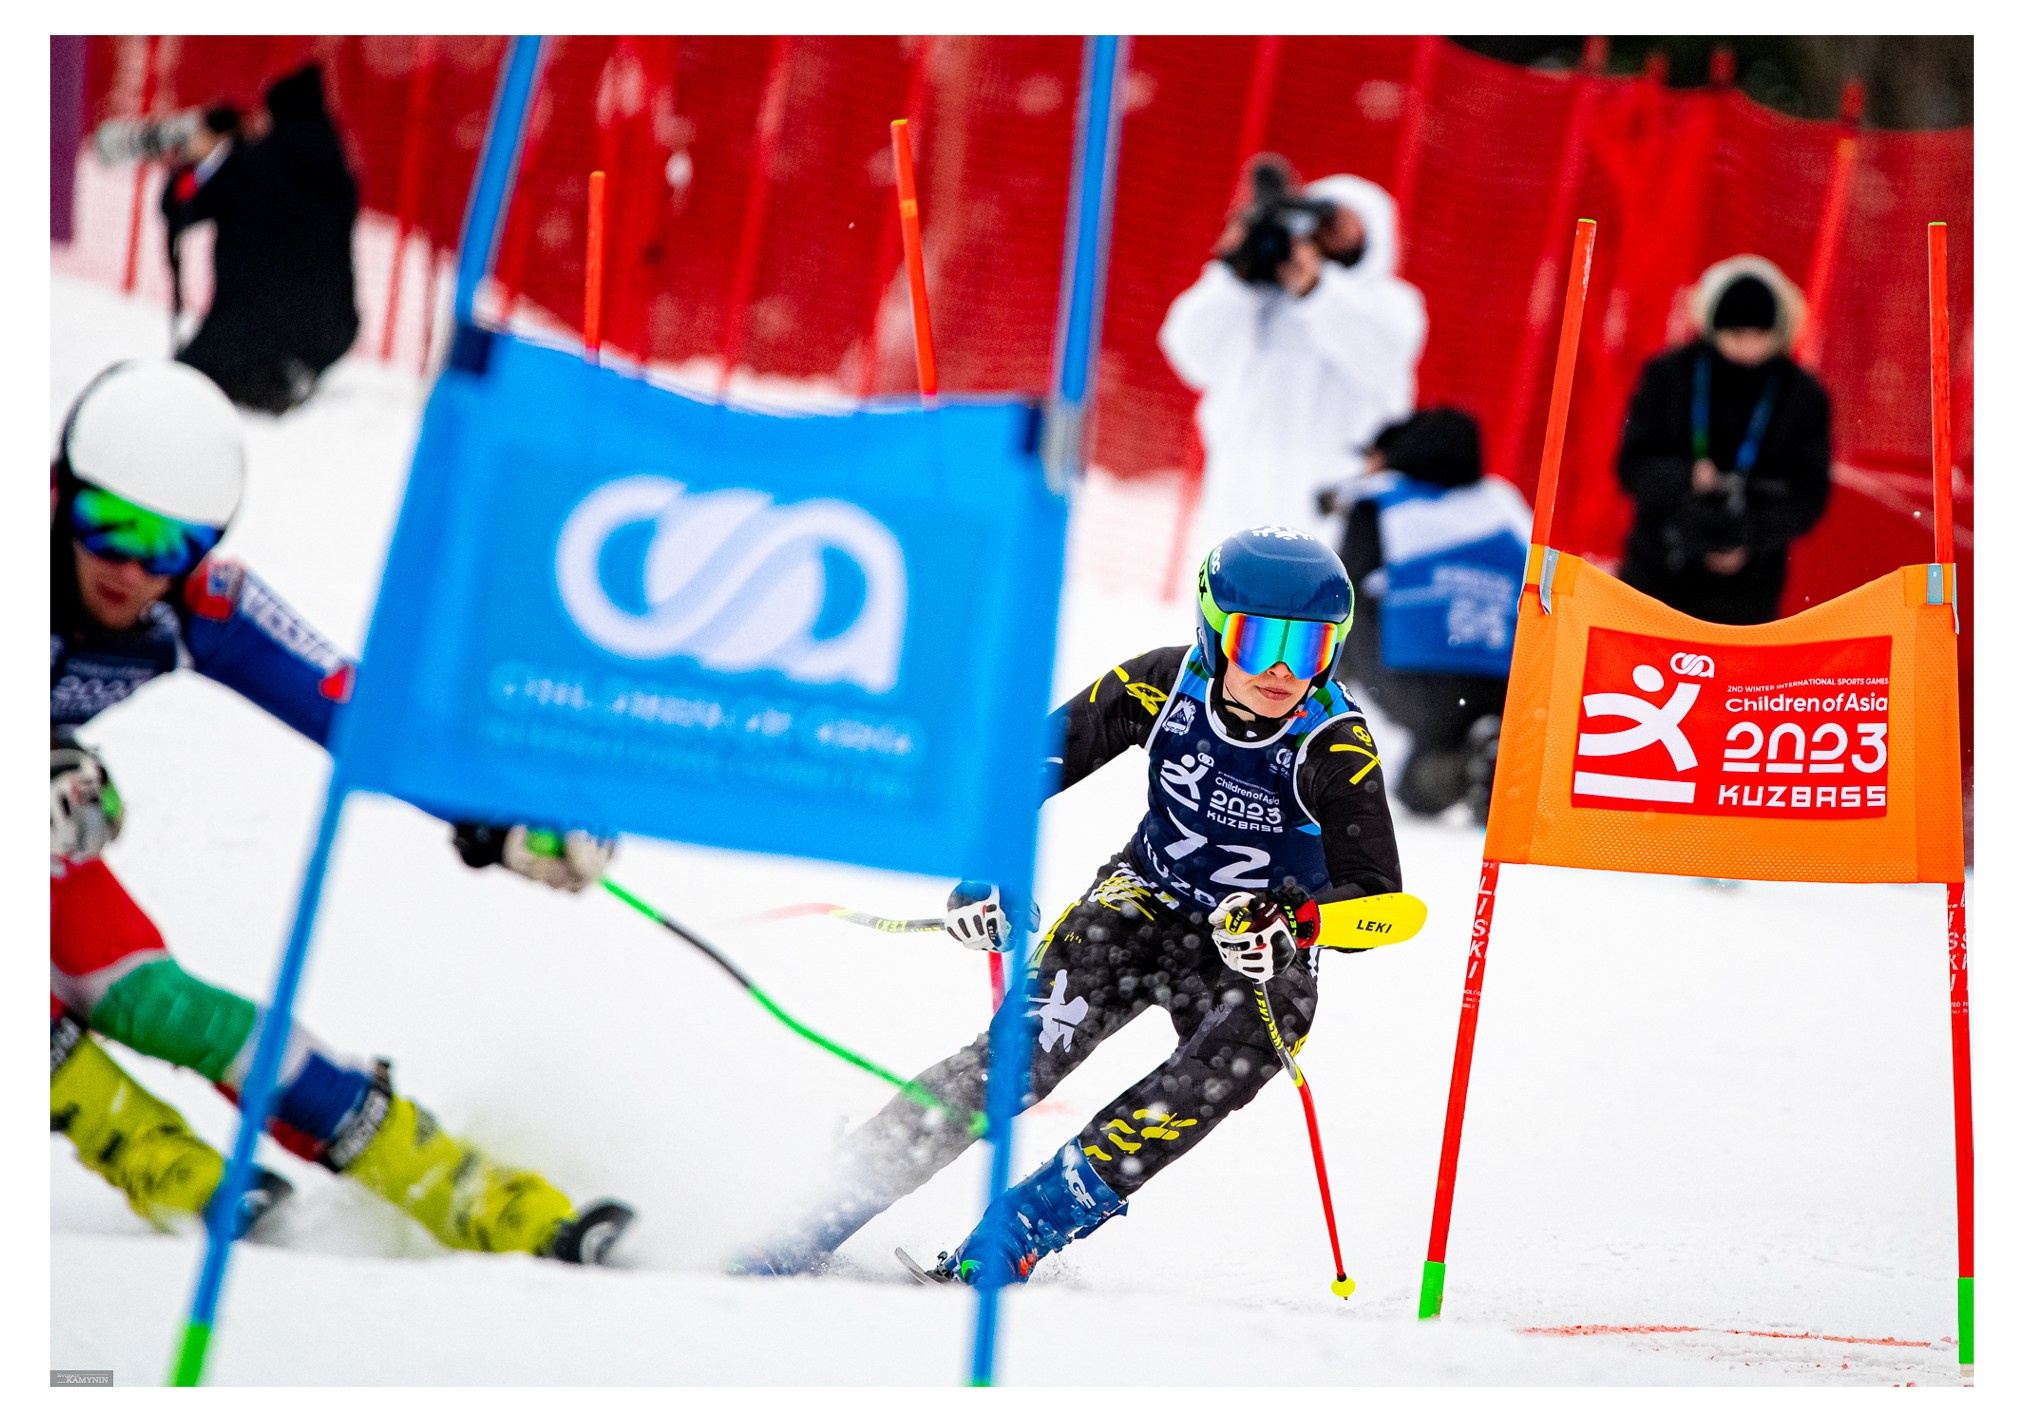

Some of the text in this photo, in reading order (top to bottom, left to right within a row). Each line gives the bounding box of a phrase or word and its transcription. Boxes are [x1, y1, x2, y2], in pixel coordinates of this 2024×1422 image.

[1727, 677, 1889, 693] 2ND WINTER INTERNATIONAL SPORTS GAMES
[1725, 692, 1889, 713] Children of Asia
[1722, 721, 1888, 774] 2023
[1215, 776, 1253, 799] Children
[1252, 792, 1264, 801] of
[1262, 794, 1280, 806] Asia
[1718, 784, 1888, 809] KUZBASS
[1209, 789, 1283, 825] 2023
[1206, 810, 1284, 833] KUZBASS
[1230, 911, 1244, 932] LEKI
[1284, 905, 1297, 936] LEKI
[1356, 919, 1393, 934] LEKI
